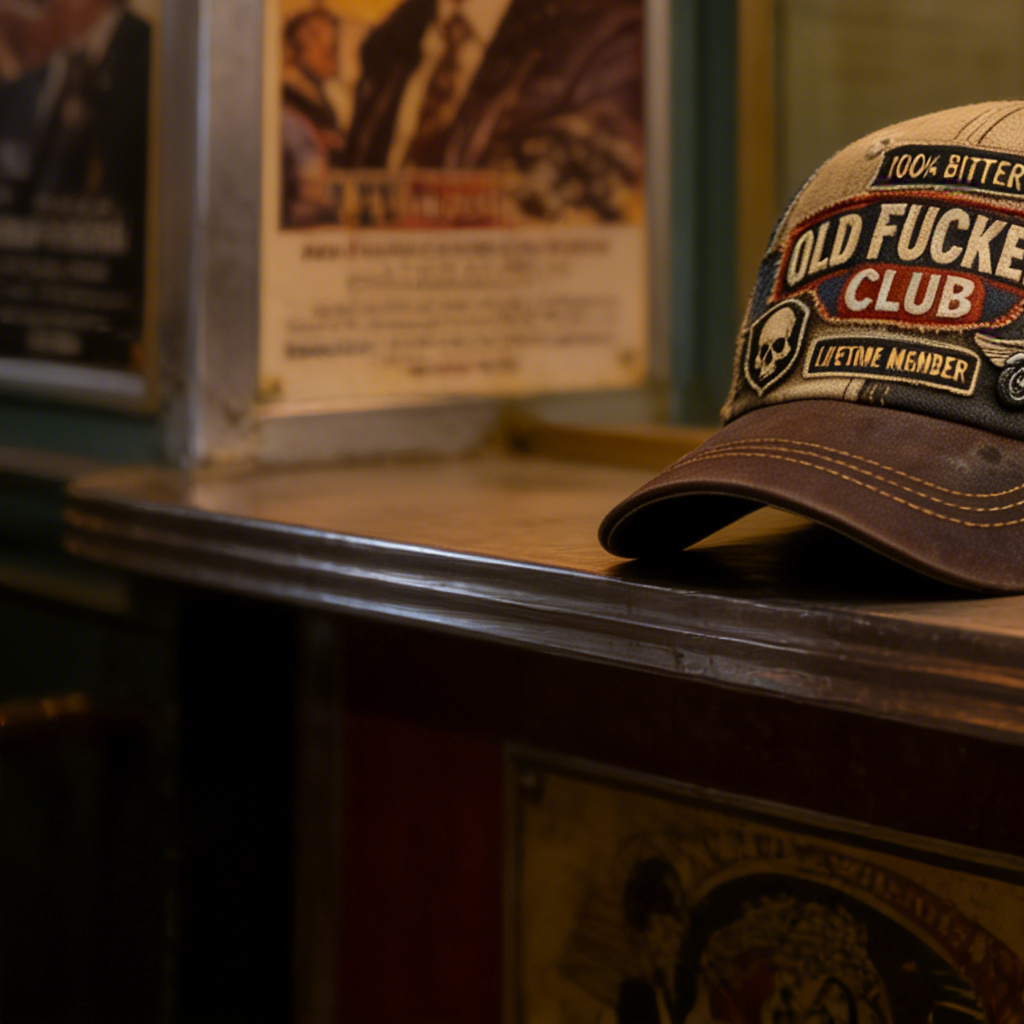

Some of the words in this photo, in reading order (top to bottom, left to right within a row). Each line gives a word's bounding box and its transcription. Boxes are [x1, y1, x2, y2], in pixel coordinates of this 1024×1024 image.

[888, 153, 940, 180] 100%
[786, 213, 863, 287] OLD
[844, 268, 975, 319] CLUB
